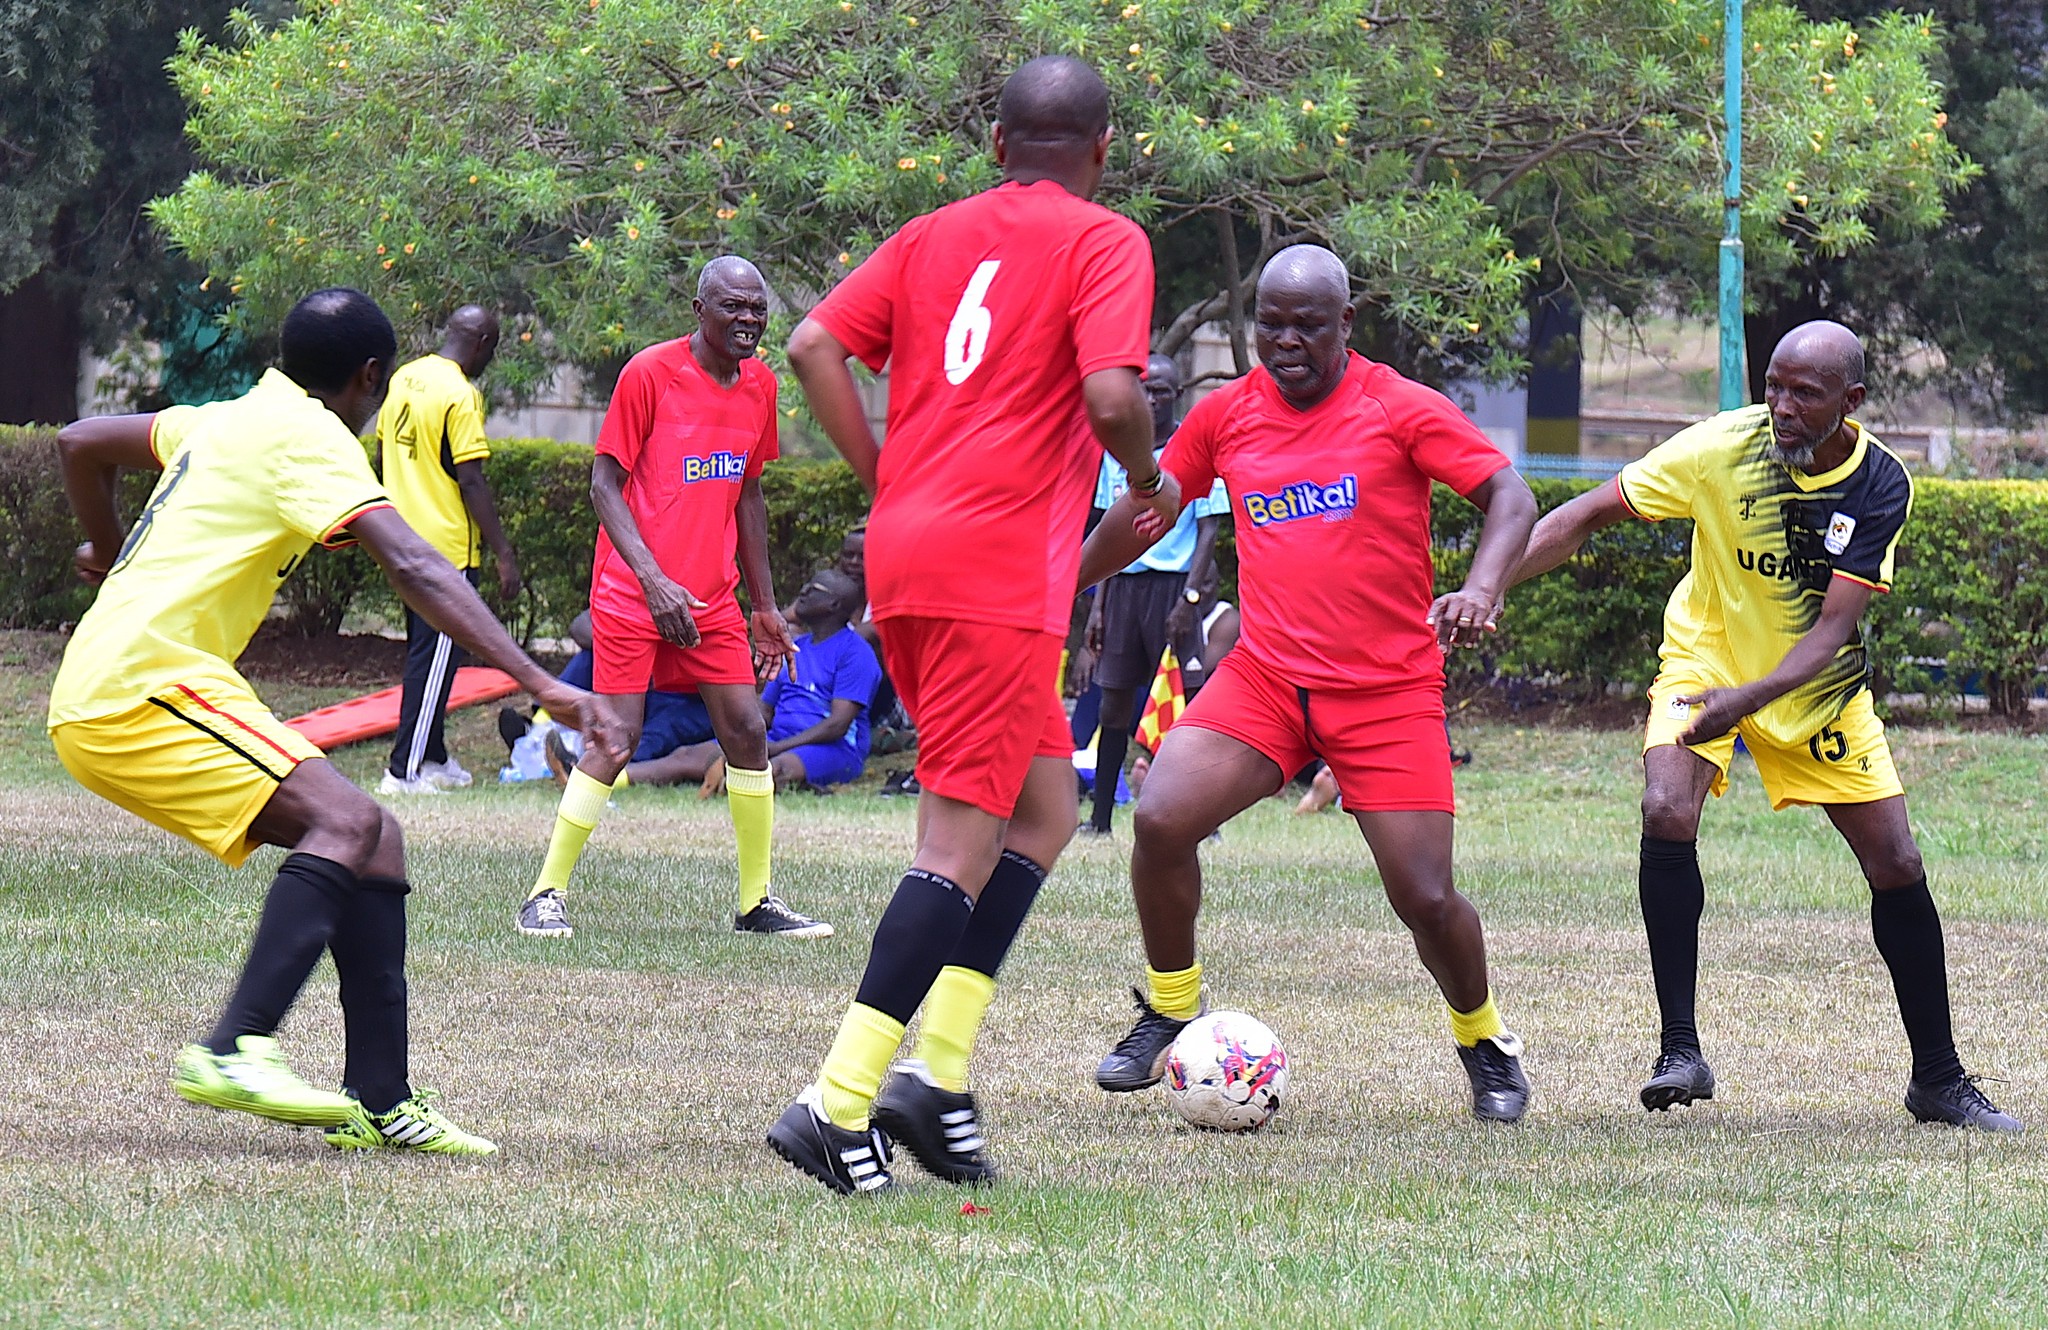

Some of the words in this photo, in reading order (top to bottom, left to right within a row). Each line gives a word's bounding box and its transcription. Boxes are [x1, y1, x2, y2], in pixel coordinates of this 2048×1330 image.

[943, 259, 1001, 386] 6
[394, 402, 418, 460] 4
[685, 450, 747, 482] Betika!
[1243, 476, 1356, 525] Betika!
